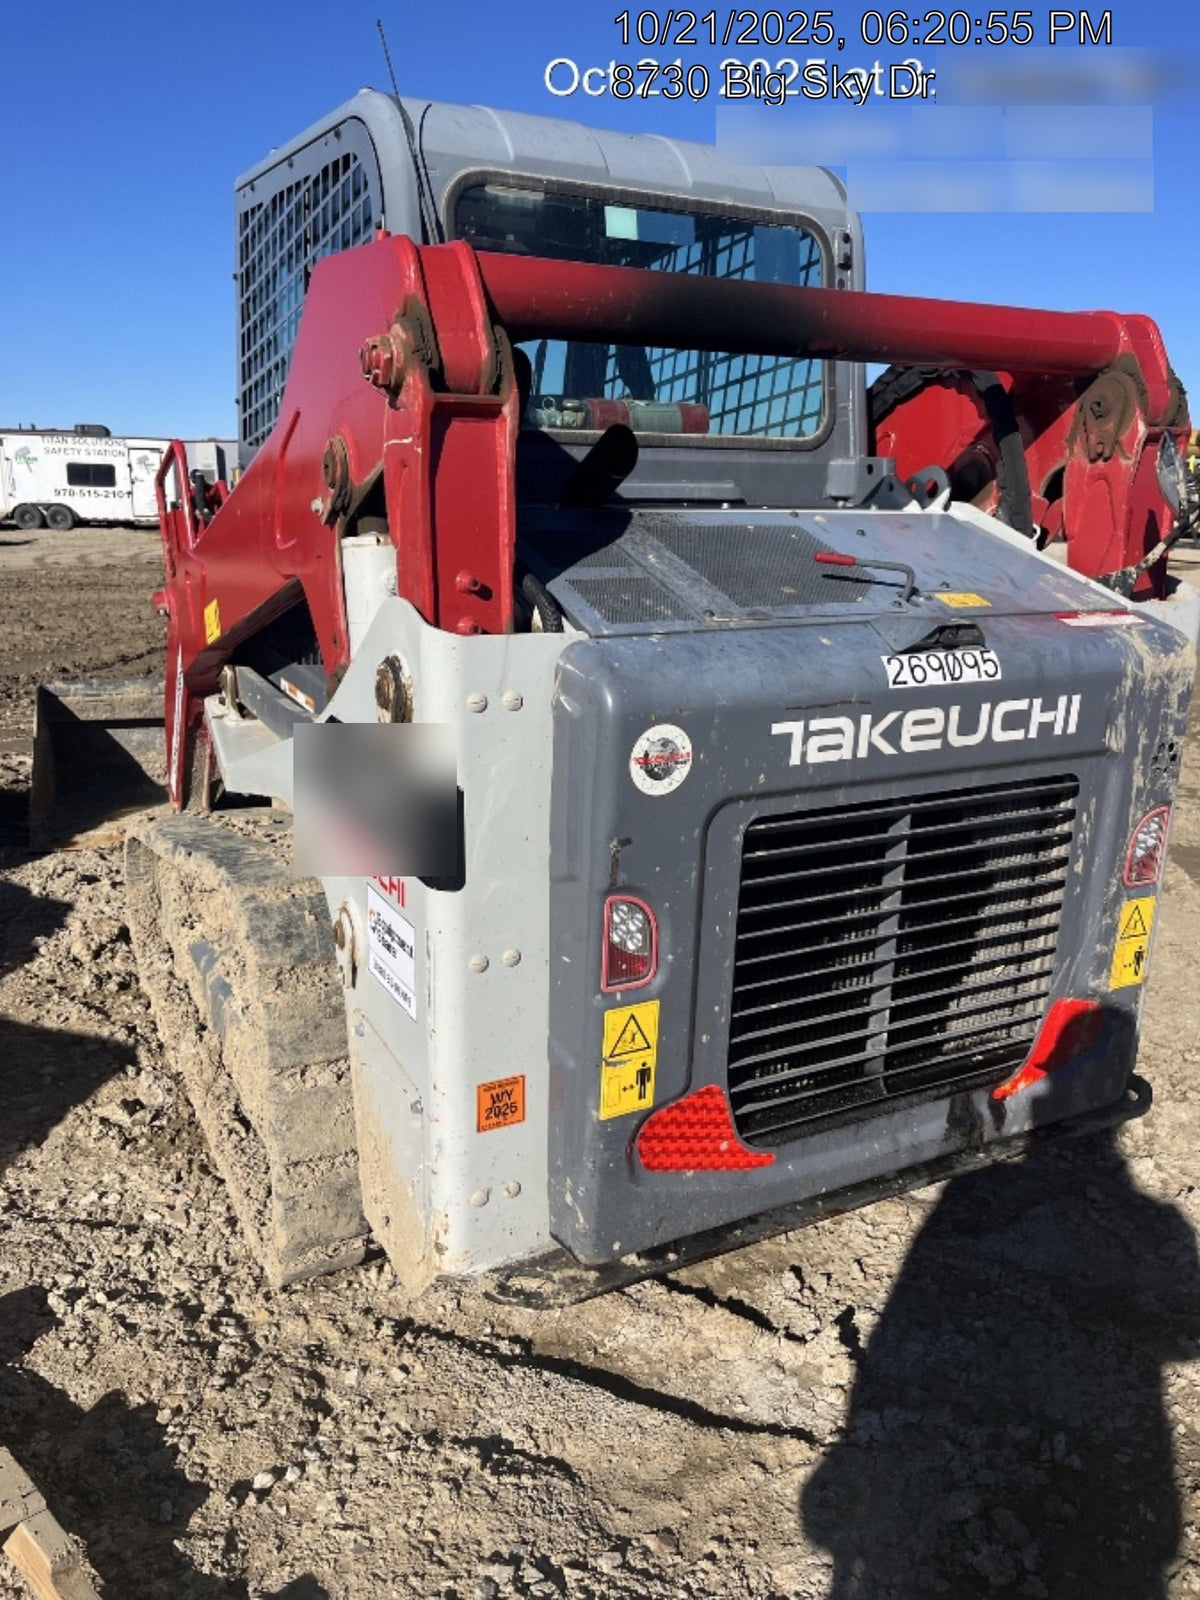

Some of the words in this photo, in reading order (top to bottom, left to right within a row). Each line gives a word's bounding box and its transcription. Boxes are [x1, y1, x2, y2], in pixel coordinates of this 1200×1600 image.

[43, 447, 81, 456] SAFETY
[84, 447, 125, 457] STATION
[771, 693, 1082, 767] TAKEUCHI
